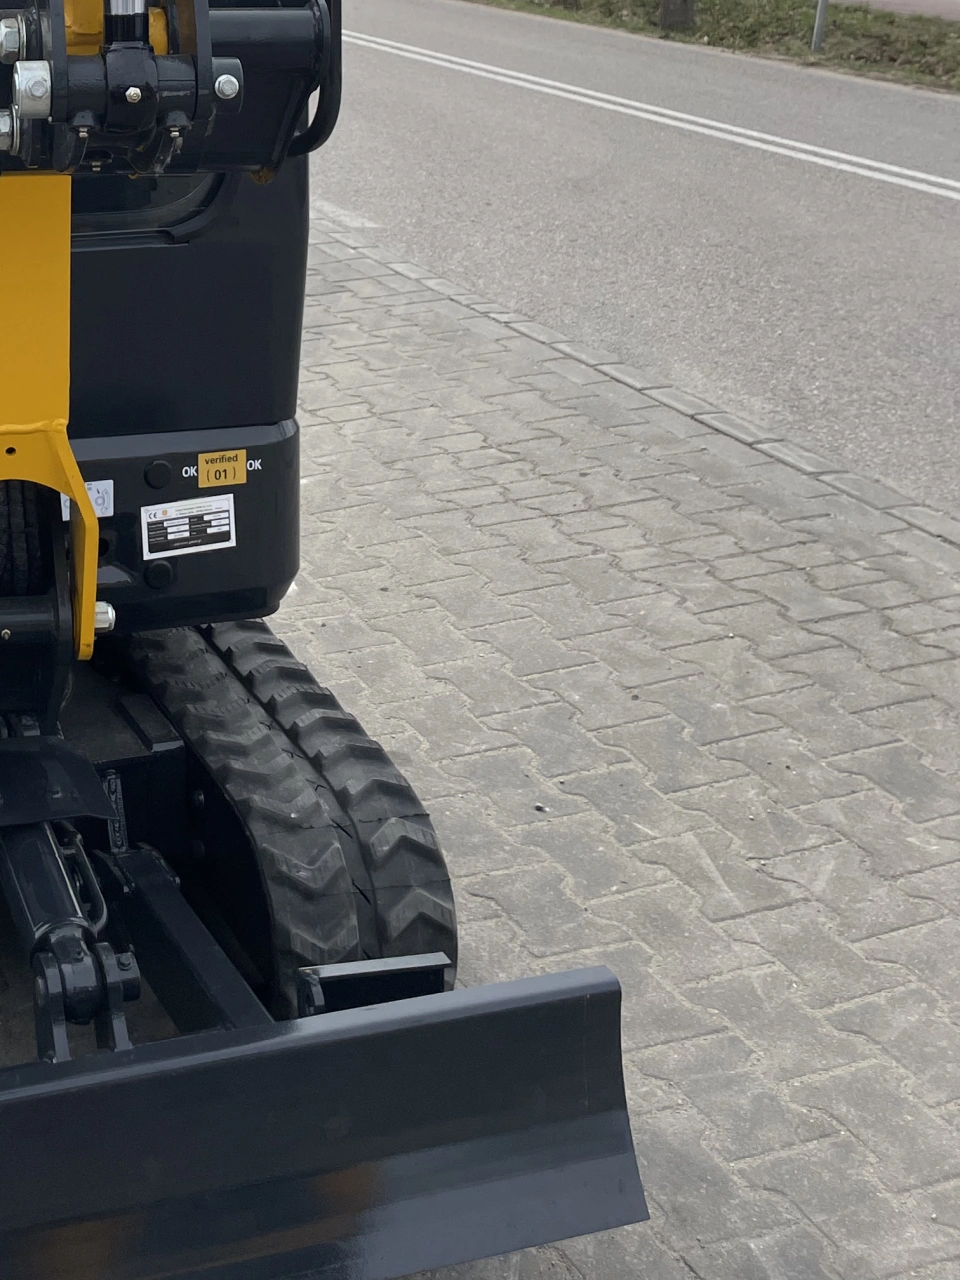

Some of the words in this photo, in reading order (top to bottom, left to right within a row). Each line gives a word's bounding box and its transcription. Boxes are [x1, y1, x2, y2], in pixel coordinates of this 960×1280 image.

[204, 453, 238, 465] verified
[247, 459, 262, 470] OK
[182, 466, 198, 477] OK
